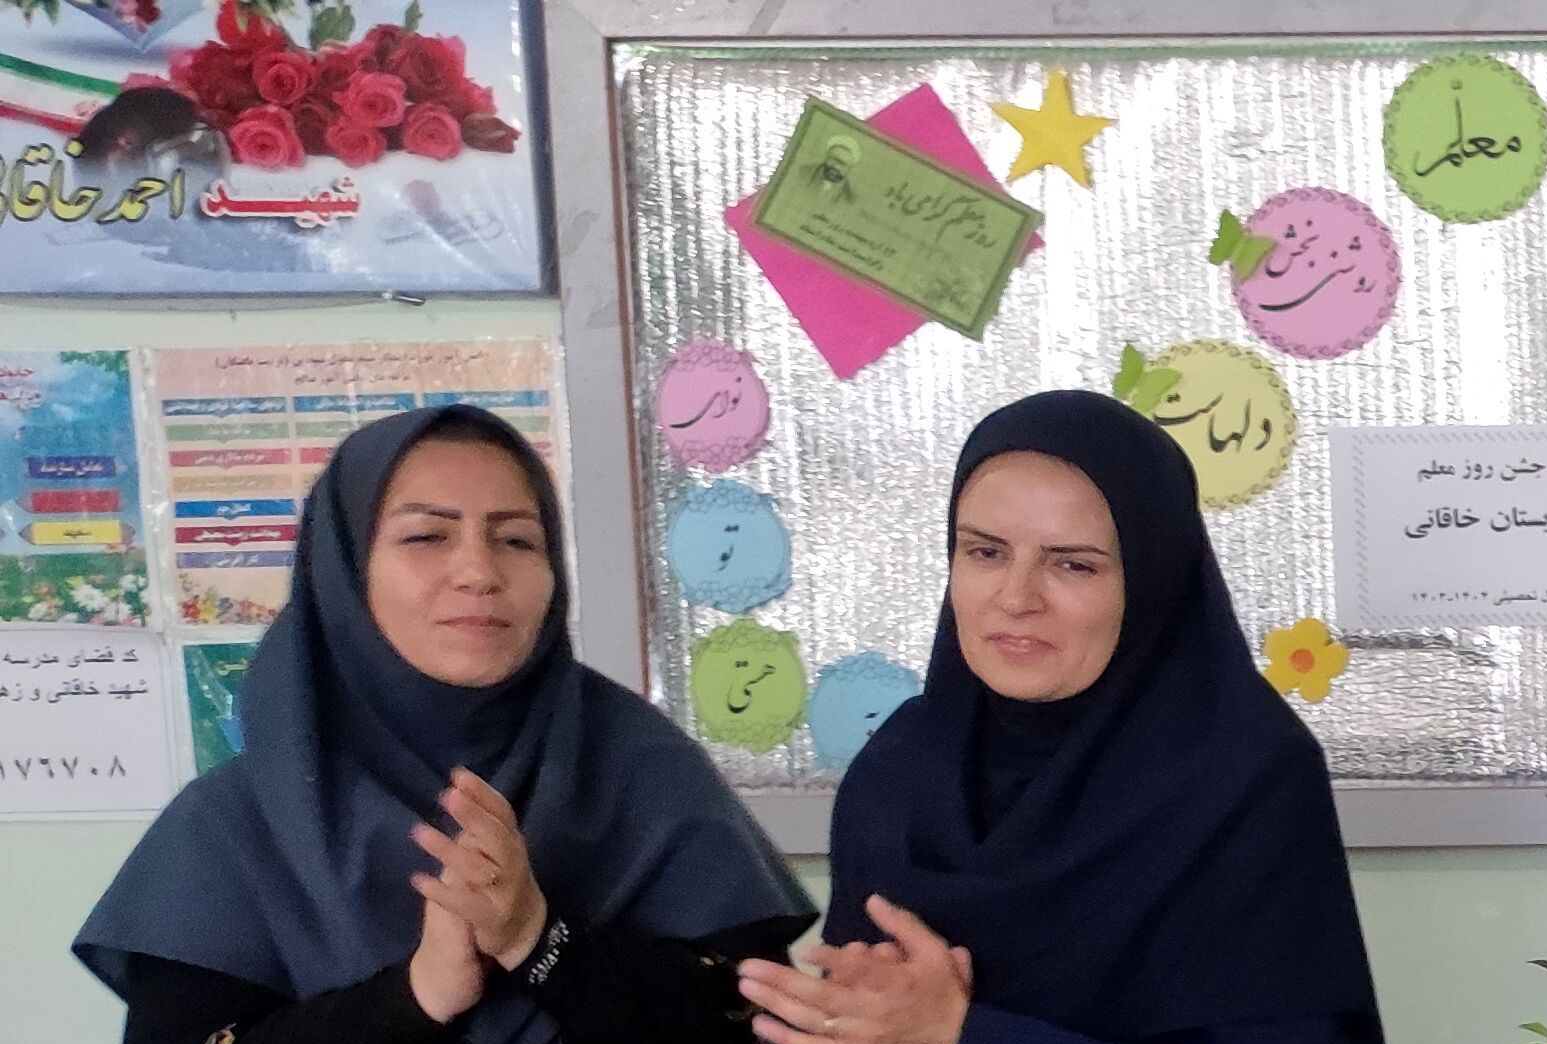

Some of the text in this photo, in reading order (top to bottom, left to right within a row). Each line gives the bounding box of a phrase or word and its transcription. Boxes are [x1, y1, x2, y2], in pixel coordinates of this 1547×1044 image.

[97, 167, 186, 225] احمد
[201, 175, 362, 229] شهید
[1417, 457, 1547, 482] جشن روز معلم
[1404, 506, 1481, 539] خاقانی
[716, 524, 741, 572] تو
[107, 678, 149, 700] شهید
[726, 661, 777, 714] هستی
